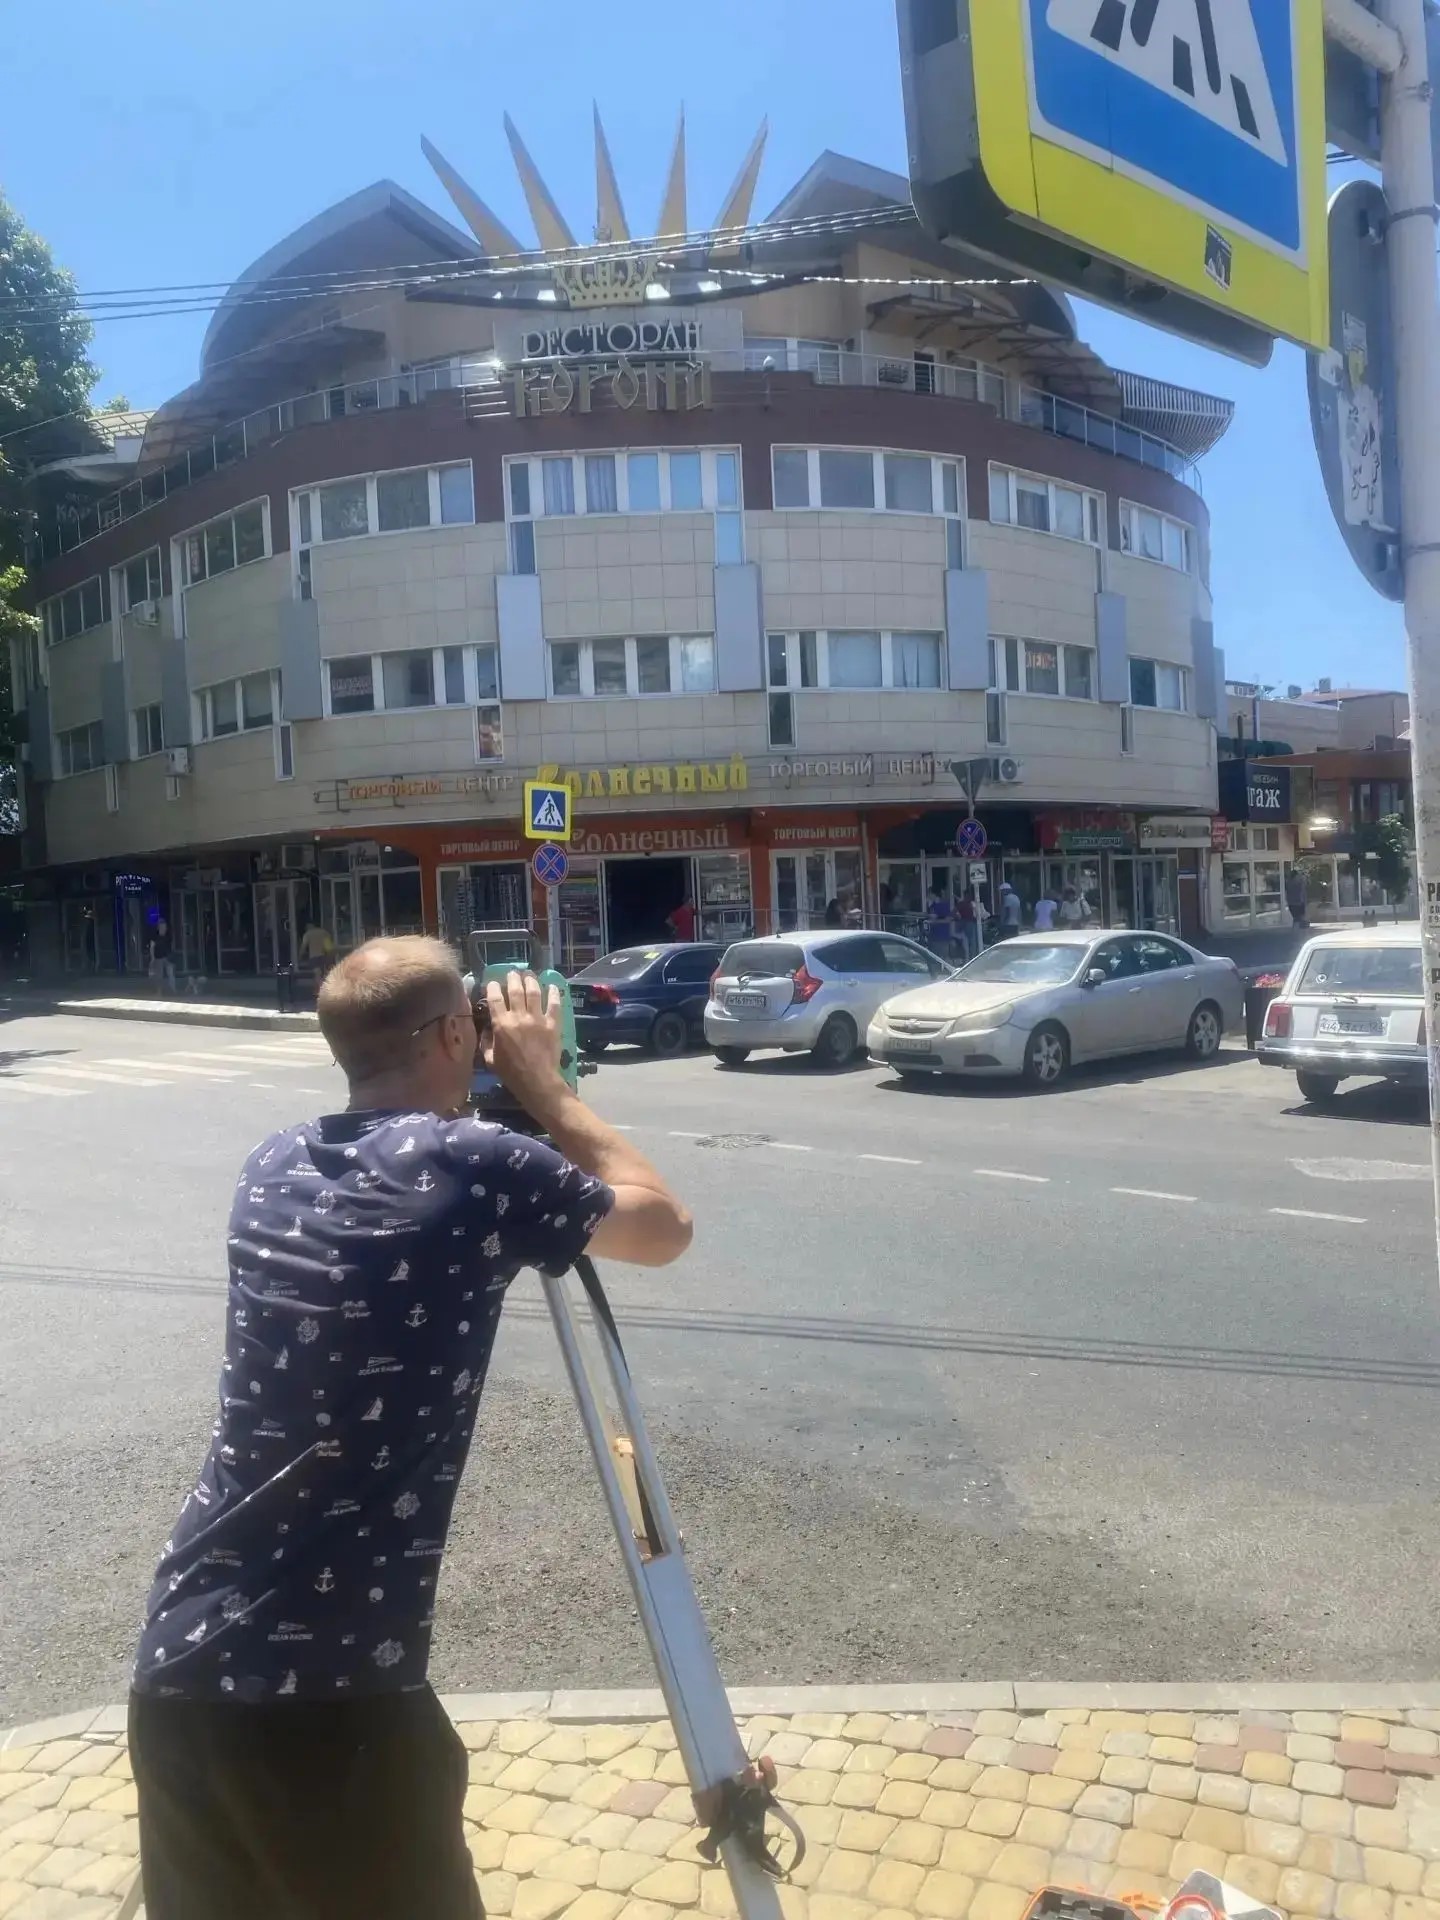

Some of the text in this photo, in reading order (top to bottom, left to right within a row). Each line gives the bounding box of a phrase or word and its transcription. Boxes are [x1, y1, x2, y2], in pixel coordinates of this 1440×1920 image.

[521, 318, 704, 360] РЕСТОРАН
[768, 757, 944, 778] ТОРГОВЫЙ ЦЕНТР
[774, 825, 859, 841] ТОРГОВЫЙ ЦЕНТР
